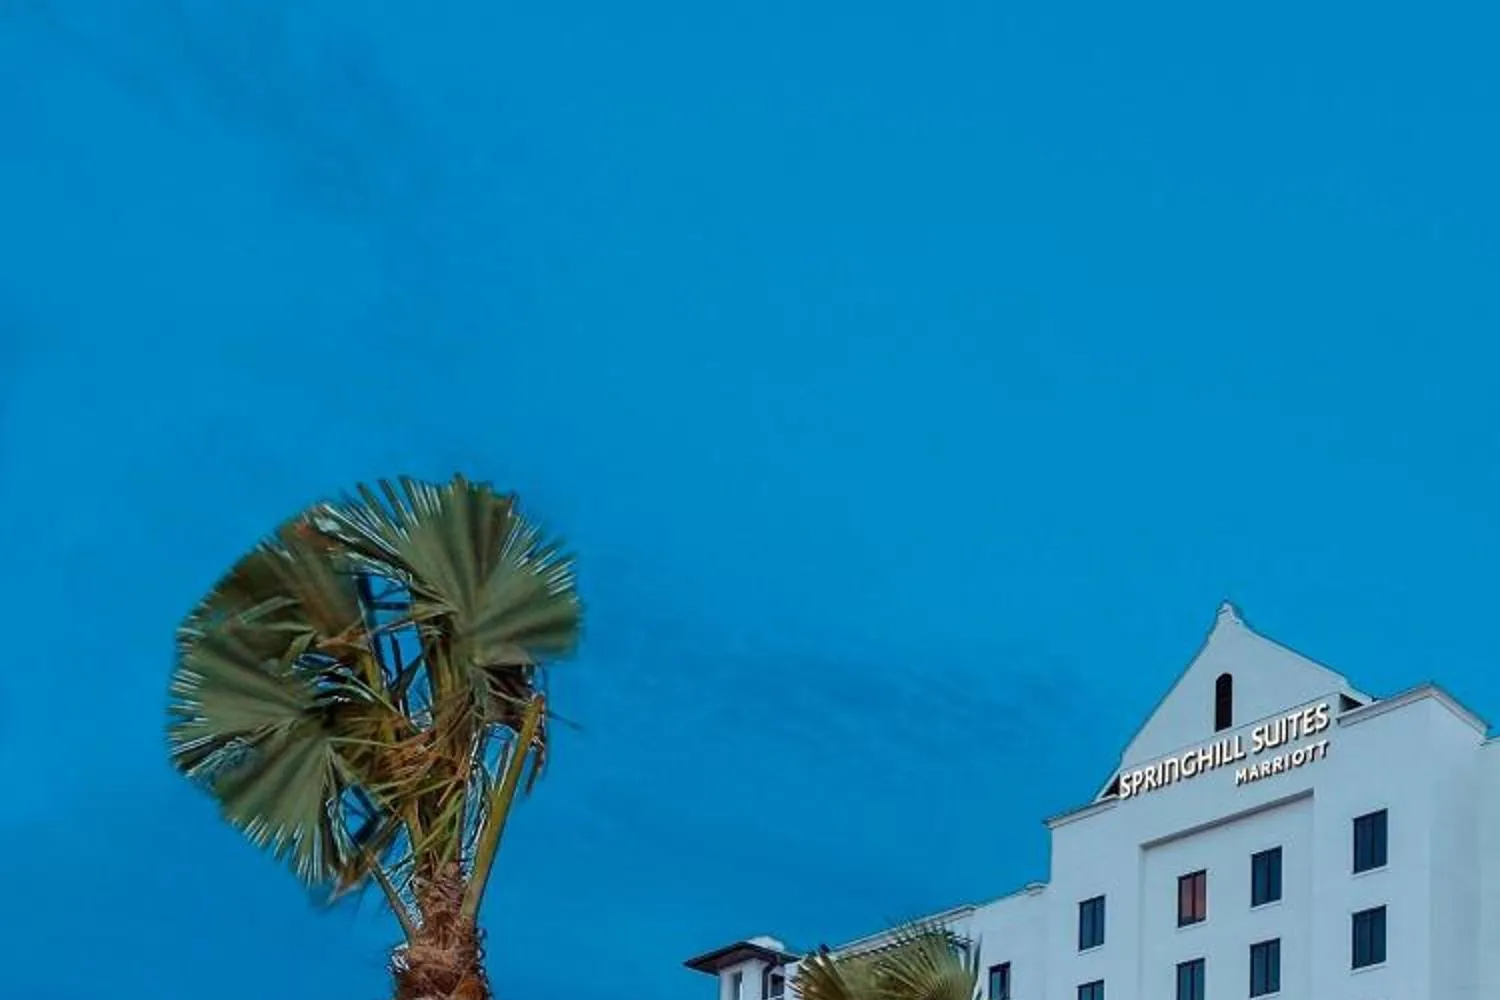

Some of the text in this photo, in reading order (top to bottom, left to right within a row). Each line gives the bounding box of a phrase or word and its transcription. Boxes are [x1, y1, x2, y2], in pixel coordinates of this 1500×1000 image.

[1119, 703, 1331, 799] SPRINGHILL SUITES
[1235, 740, 1330, 786] MARRIOTT
